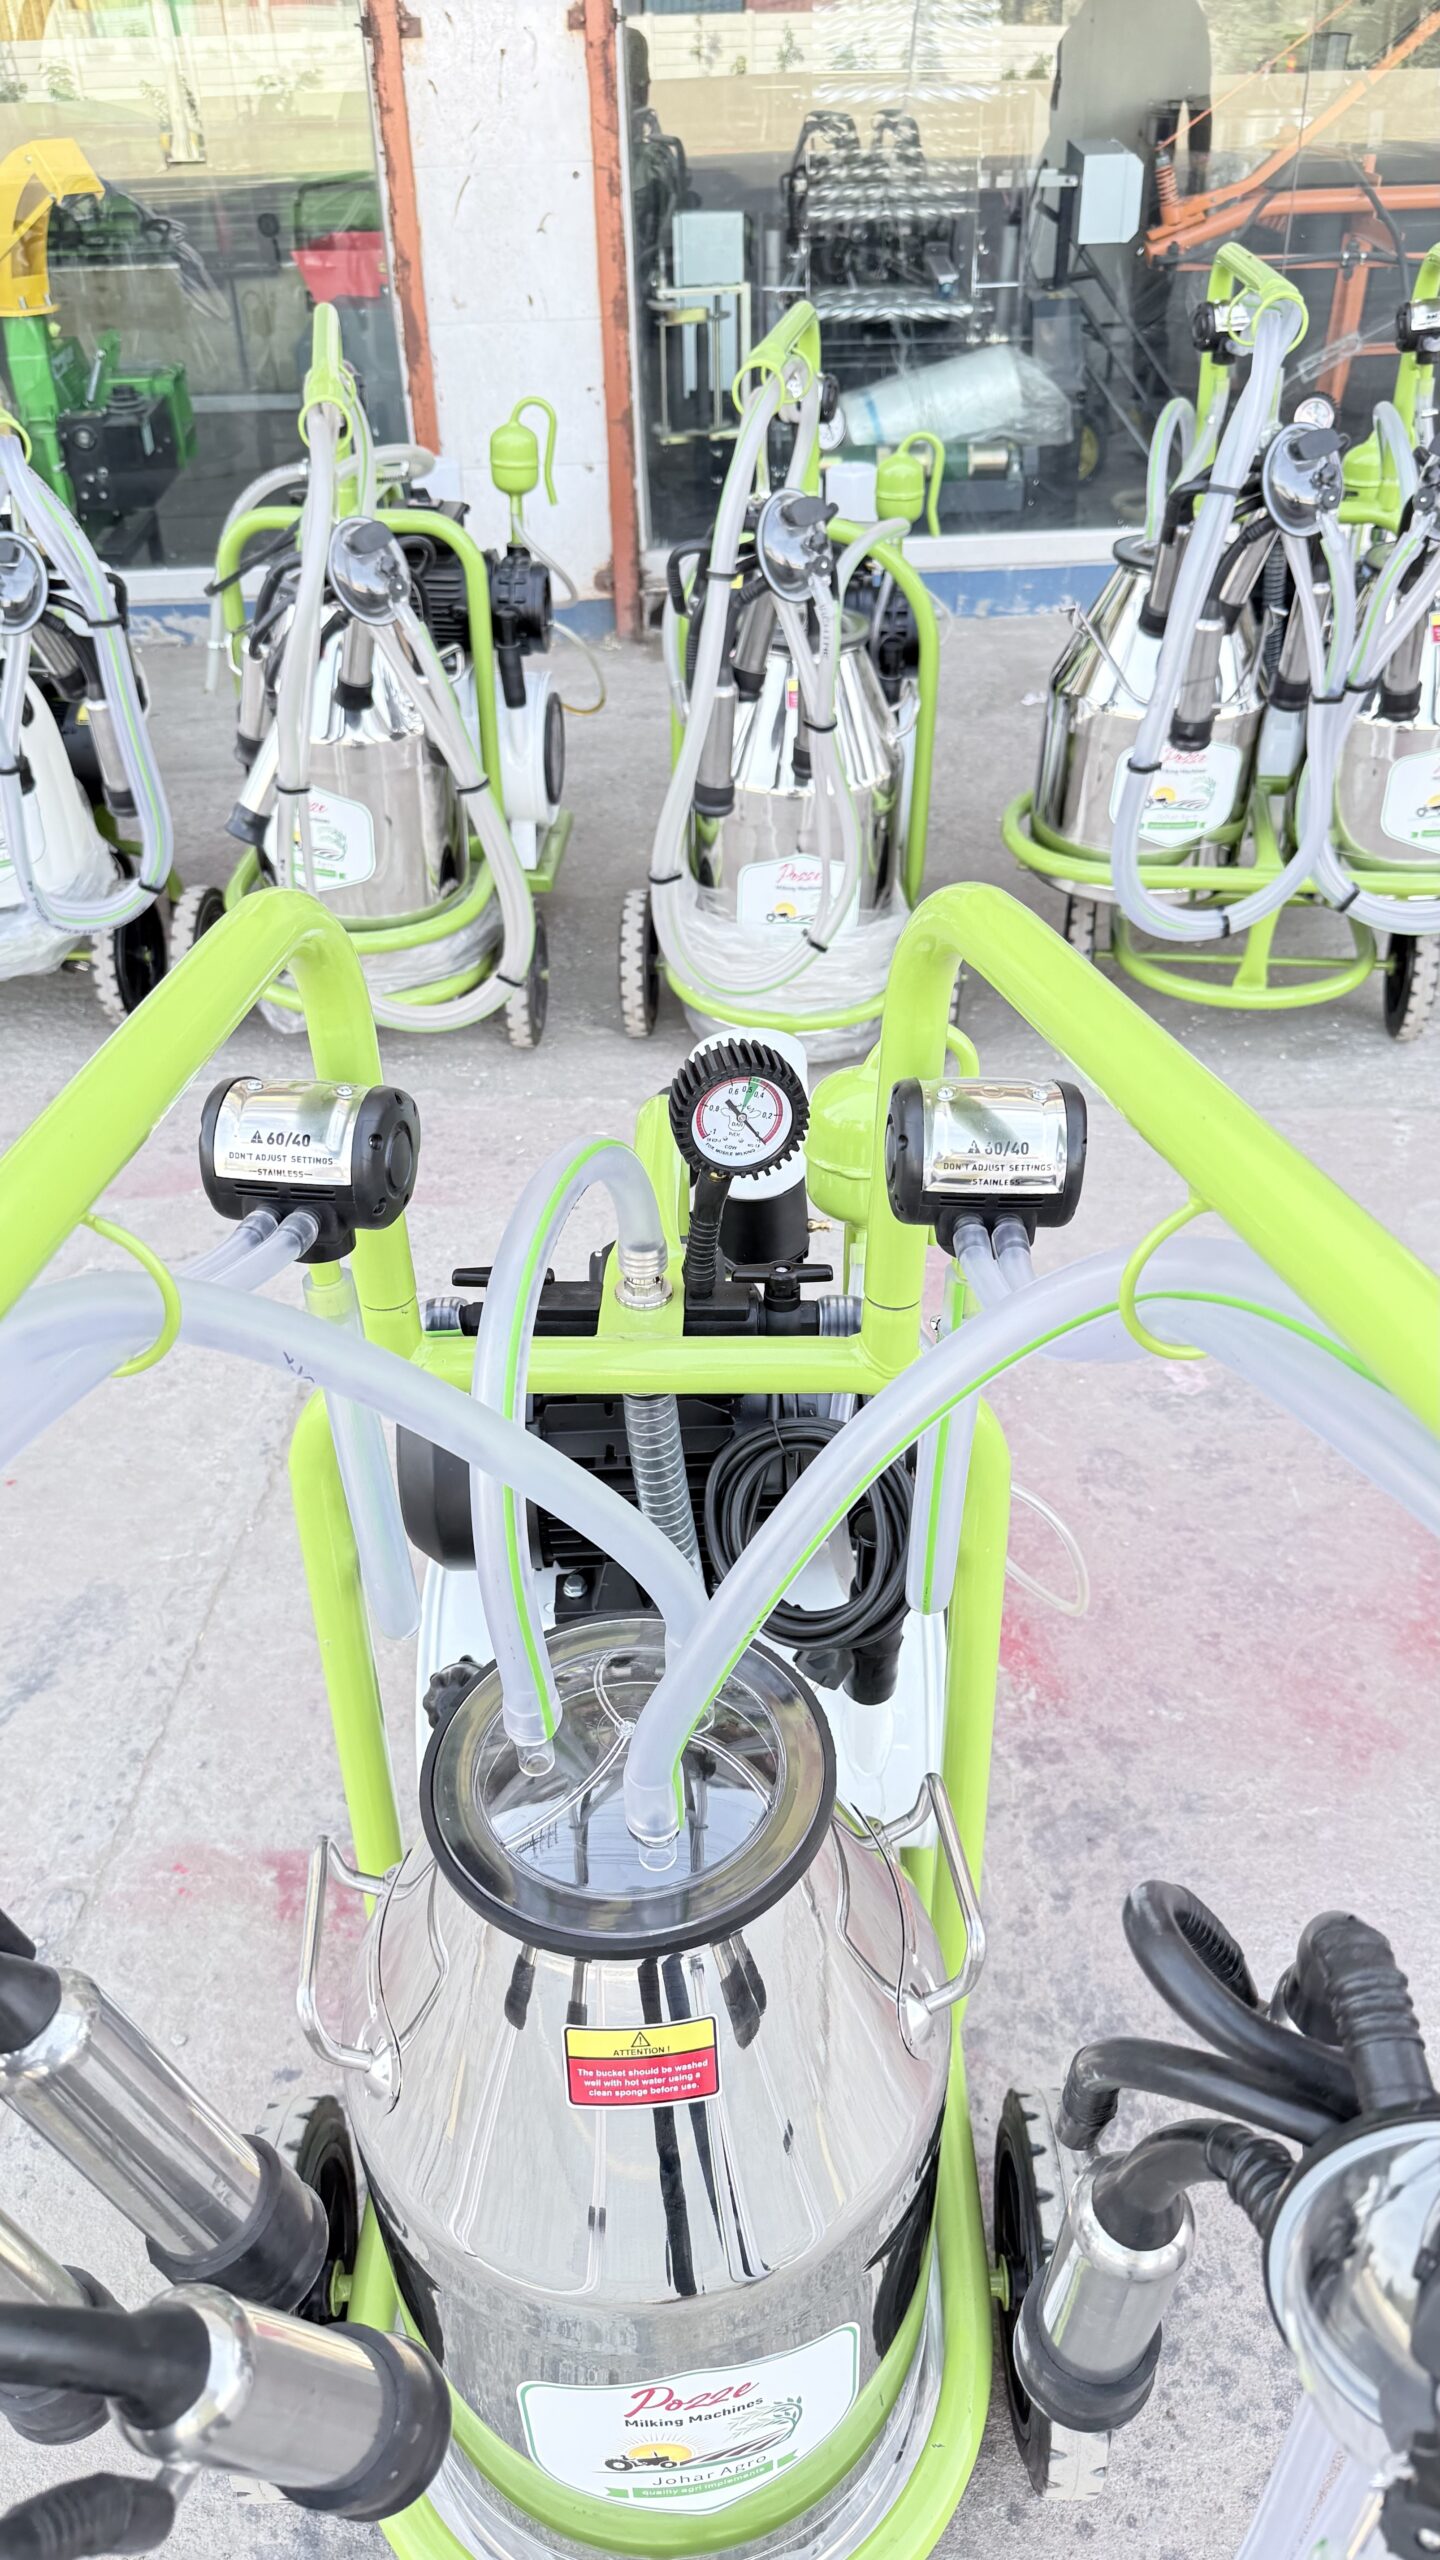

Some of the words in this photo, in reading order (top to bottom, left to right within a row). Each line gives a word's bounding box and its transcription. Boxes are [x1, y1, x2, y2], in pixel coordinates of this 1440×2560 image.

[267, 1132, 311, 1148] 60/40
[985, 1140, 1030, 1156] 60/40
[229, 1152, 253, 1160] DON'T
[256, 1153, 287, 1163] ADJUST
[291, 1155, 333, 1165] SETTINGS
[943, 1162, 969, 1170] DON'T
[972, 1163, 1005, 1172] ADJUST
[1009, 1163, 1052, 1172] SETTINGS
[613, 2046, 665, 2056] ATTENTION
[577, 2068, 593, 2077] The
[596, 2067, 626, 2077] bucket
[628, 2067, 659, 2077] should
[661, 2066, 672, 2074] be
[674, 2059, 708, 2072] washed
[584, 2079, 601, 2087] well
[603, 2079, 622, 2087] with
[624, 2078, 639, 2087] hot
[641, 2077, 666, 2086] water
[669, 2073, 693, 2084] using
[588, 2089, 612, 2097] clean
[614, 2087, 648, 2098] sponge
[650, 2084, 678, 2094] before
[681, 2082, 700, 2091] use.
[624, 2381, 759, 2418] Pozze
[624, 2418, 684, 2428] Milking
[688, 2397, 763, 2424] Machines
[652, 2471, 715, 2486] Johar
[720, 2455, 767, 2476] Agro
[642, 2487, 679, 2496] quality
[680, 2485, 702, 2494] agri
[704, 2467, 766, 2489] implements
